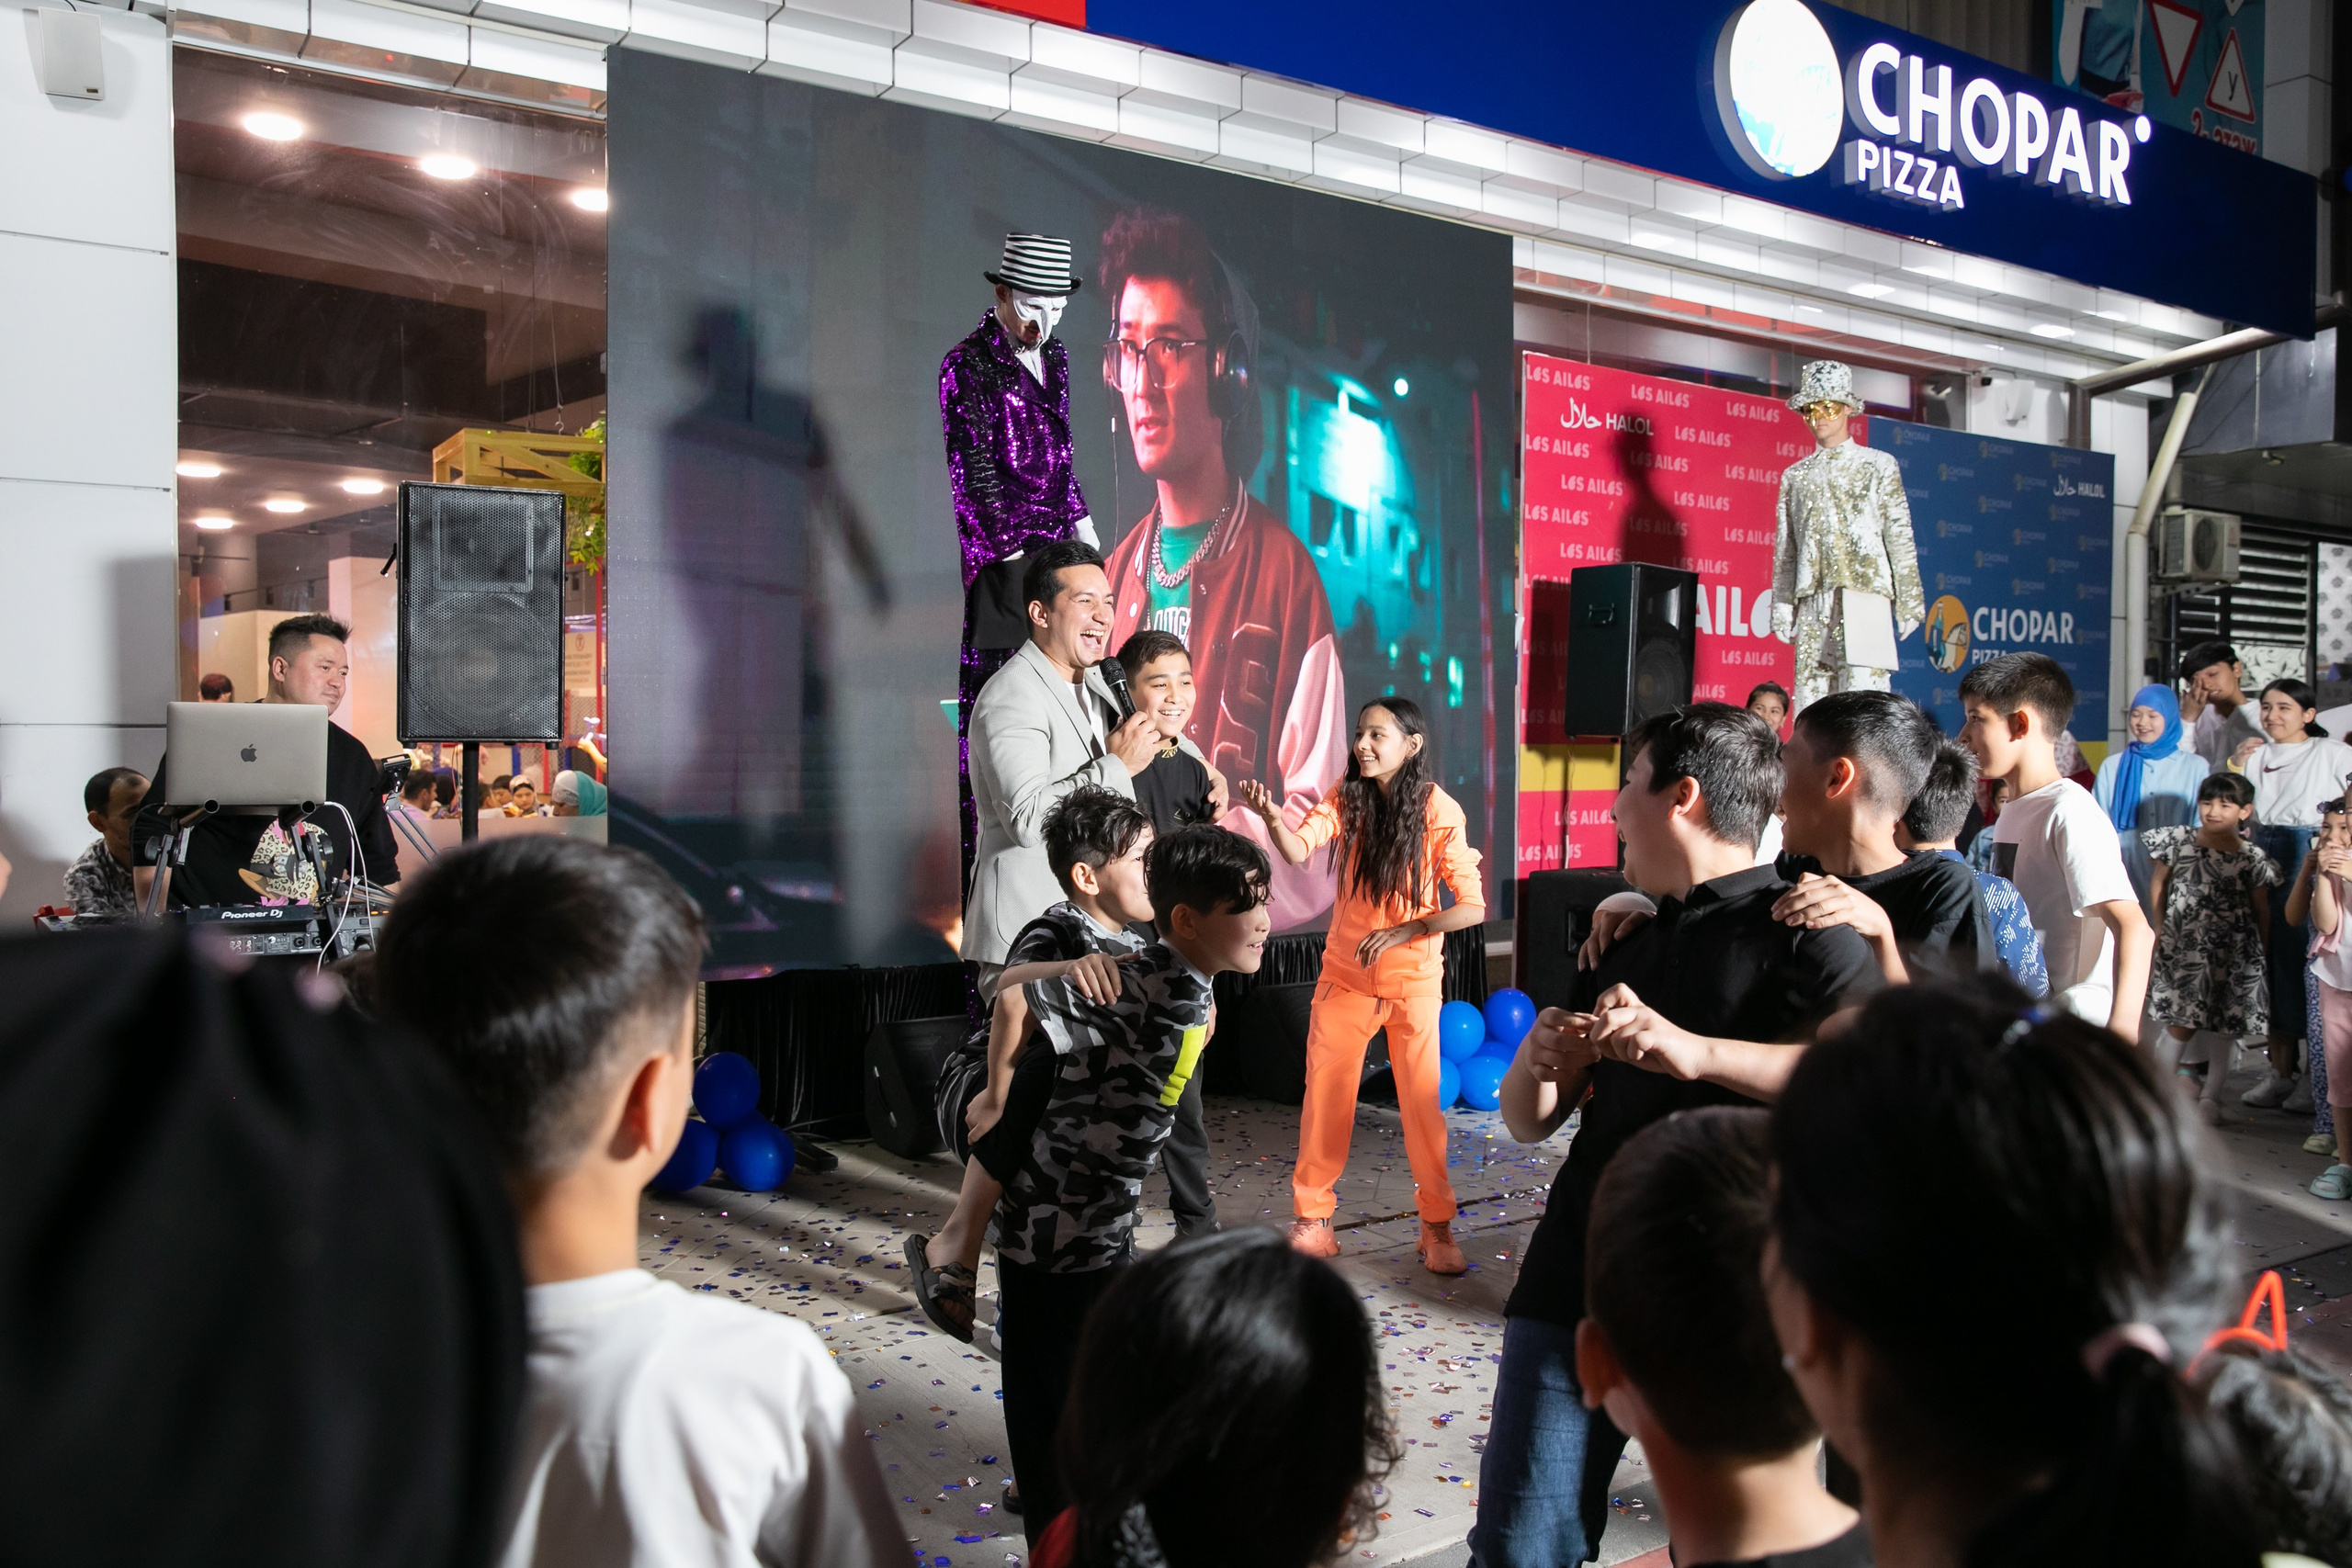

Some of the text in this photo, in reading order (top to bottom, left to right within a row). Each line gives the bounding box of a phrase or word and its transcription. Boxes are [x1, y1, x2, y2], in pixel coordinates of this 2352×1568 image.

[1856, 42, 2132, 206] CHOPAR
[1857, 138, 1964, 209] PIZZA
[1560, 397, 1654, 436] حلال HALOL
[2077, 482, 2106, 499] HALOL
[1973, 606, 2075, 644] CHOPAR
[221, 910, 268, 919] Pioneer
